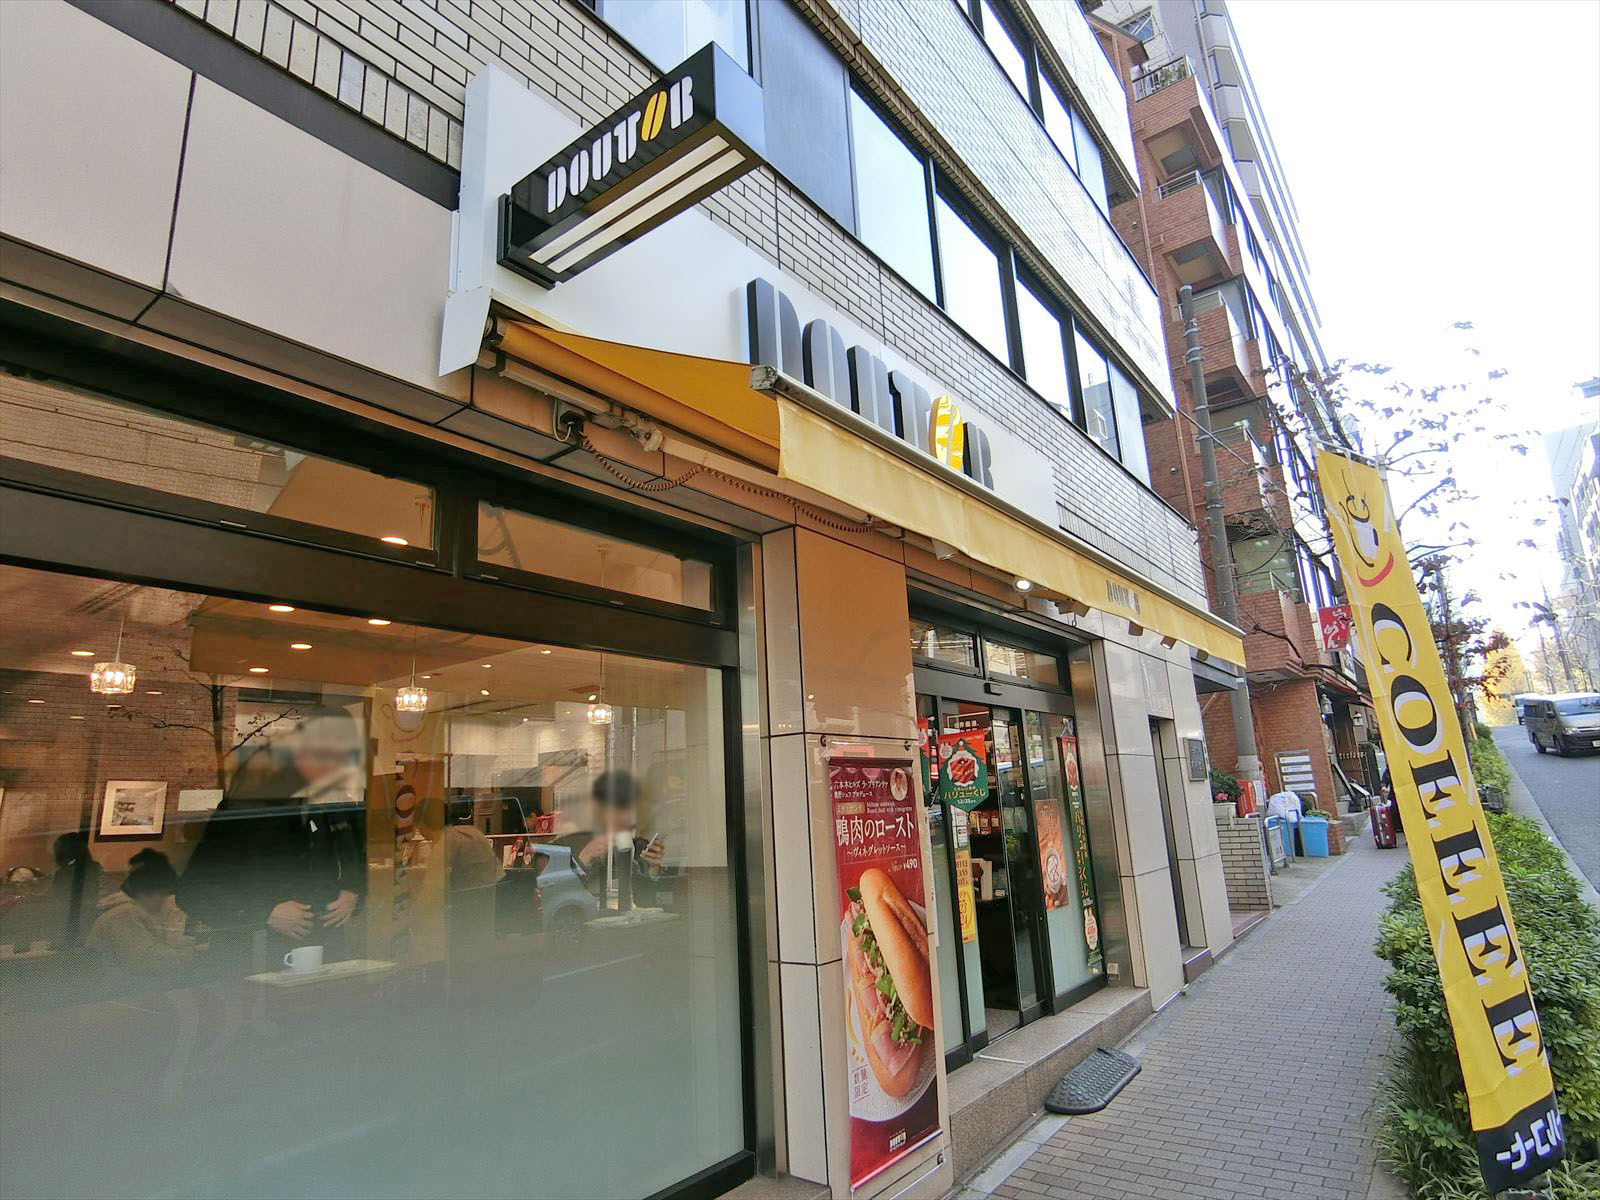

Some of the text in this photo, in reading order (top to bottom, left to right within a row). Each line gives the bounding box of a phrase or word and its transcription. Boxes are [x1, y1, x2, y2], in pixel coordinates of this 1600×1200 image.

[547, 75, 694, 214] DOUTOR
[944, 788, 985, 799] バリューくじ
[836, 813, 914, 846] 鴨肉のロースト
